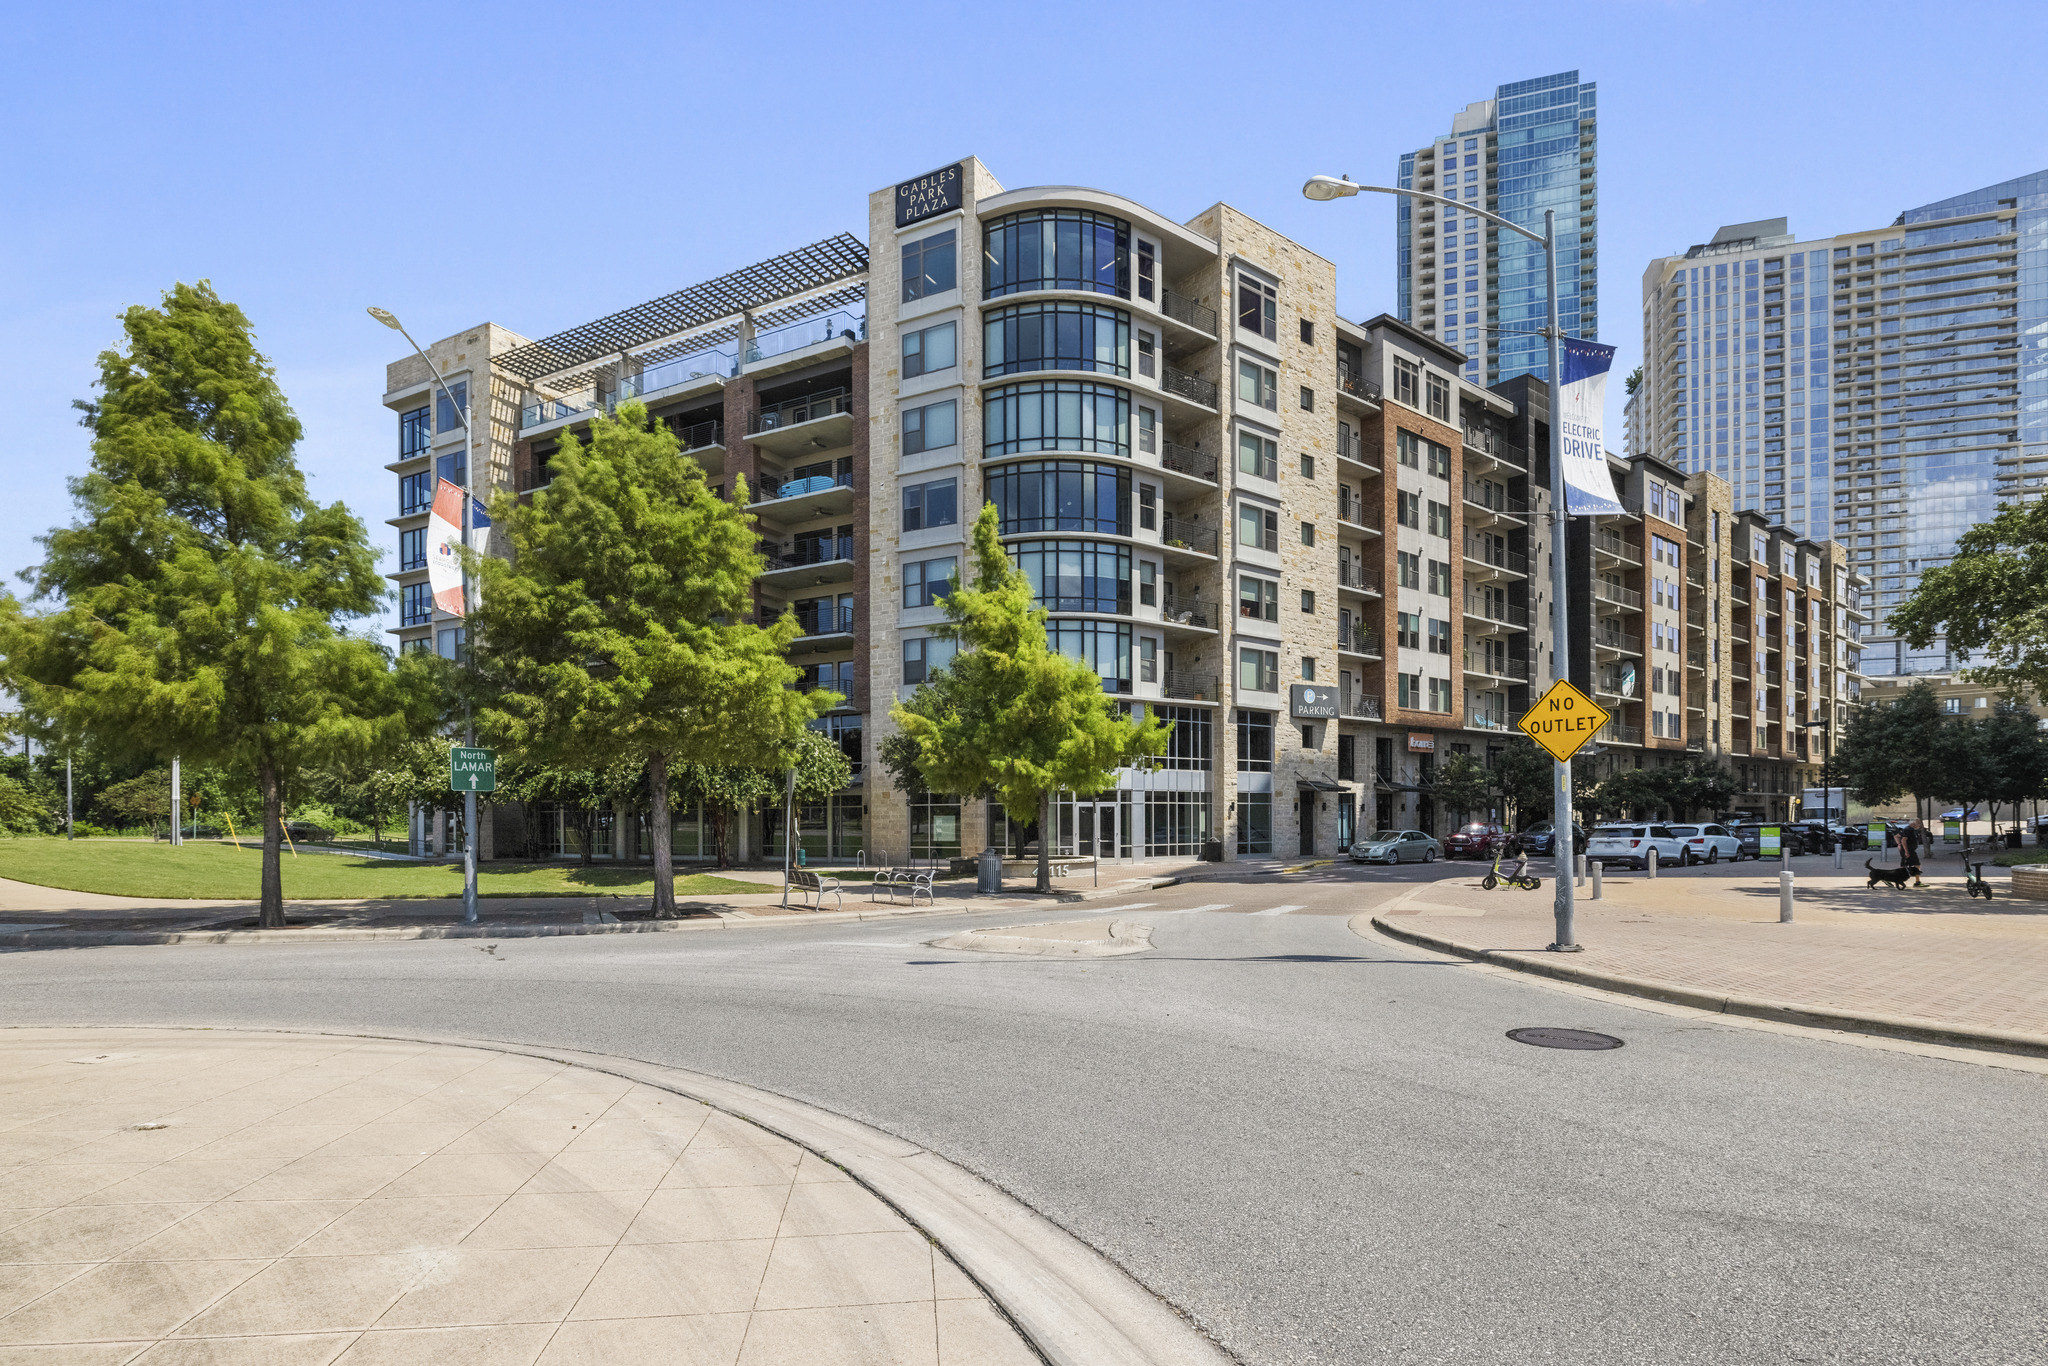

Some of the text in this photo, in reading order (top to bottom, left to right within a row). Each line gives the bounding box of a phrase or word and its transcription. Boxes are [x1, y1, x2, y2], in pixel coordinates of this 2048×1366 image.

[900, 168, 955, 197] GABLES
[910, 184, 945, 206] PARK
[906, 196, 949, 219] PLAZA
[1562, 421, 1601, 441] ELECTRIC
[1563, 436, 1603, 461] DRIVE
[1298, 705, 1335, 716] PARKING
[1549, 697, 1574, 712] NO
[1530, 716, 1597, 734] OUTLET
[460, 750, 486, 760] North
[454, 761, 493, 772] LAMAR
[1049, 864, 1070, 876] 115
